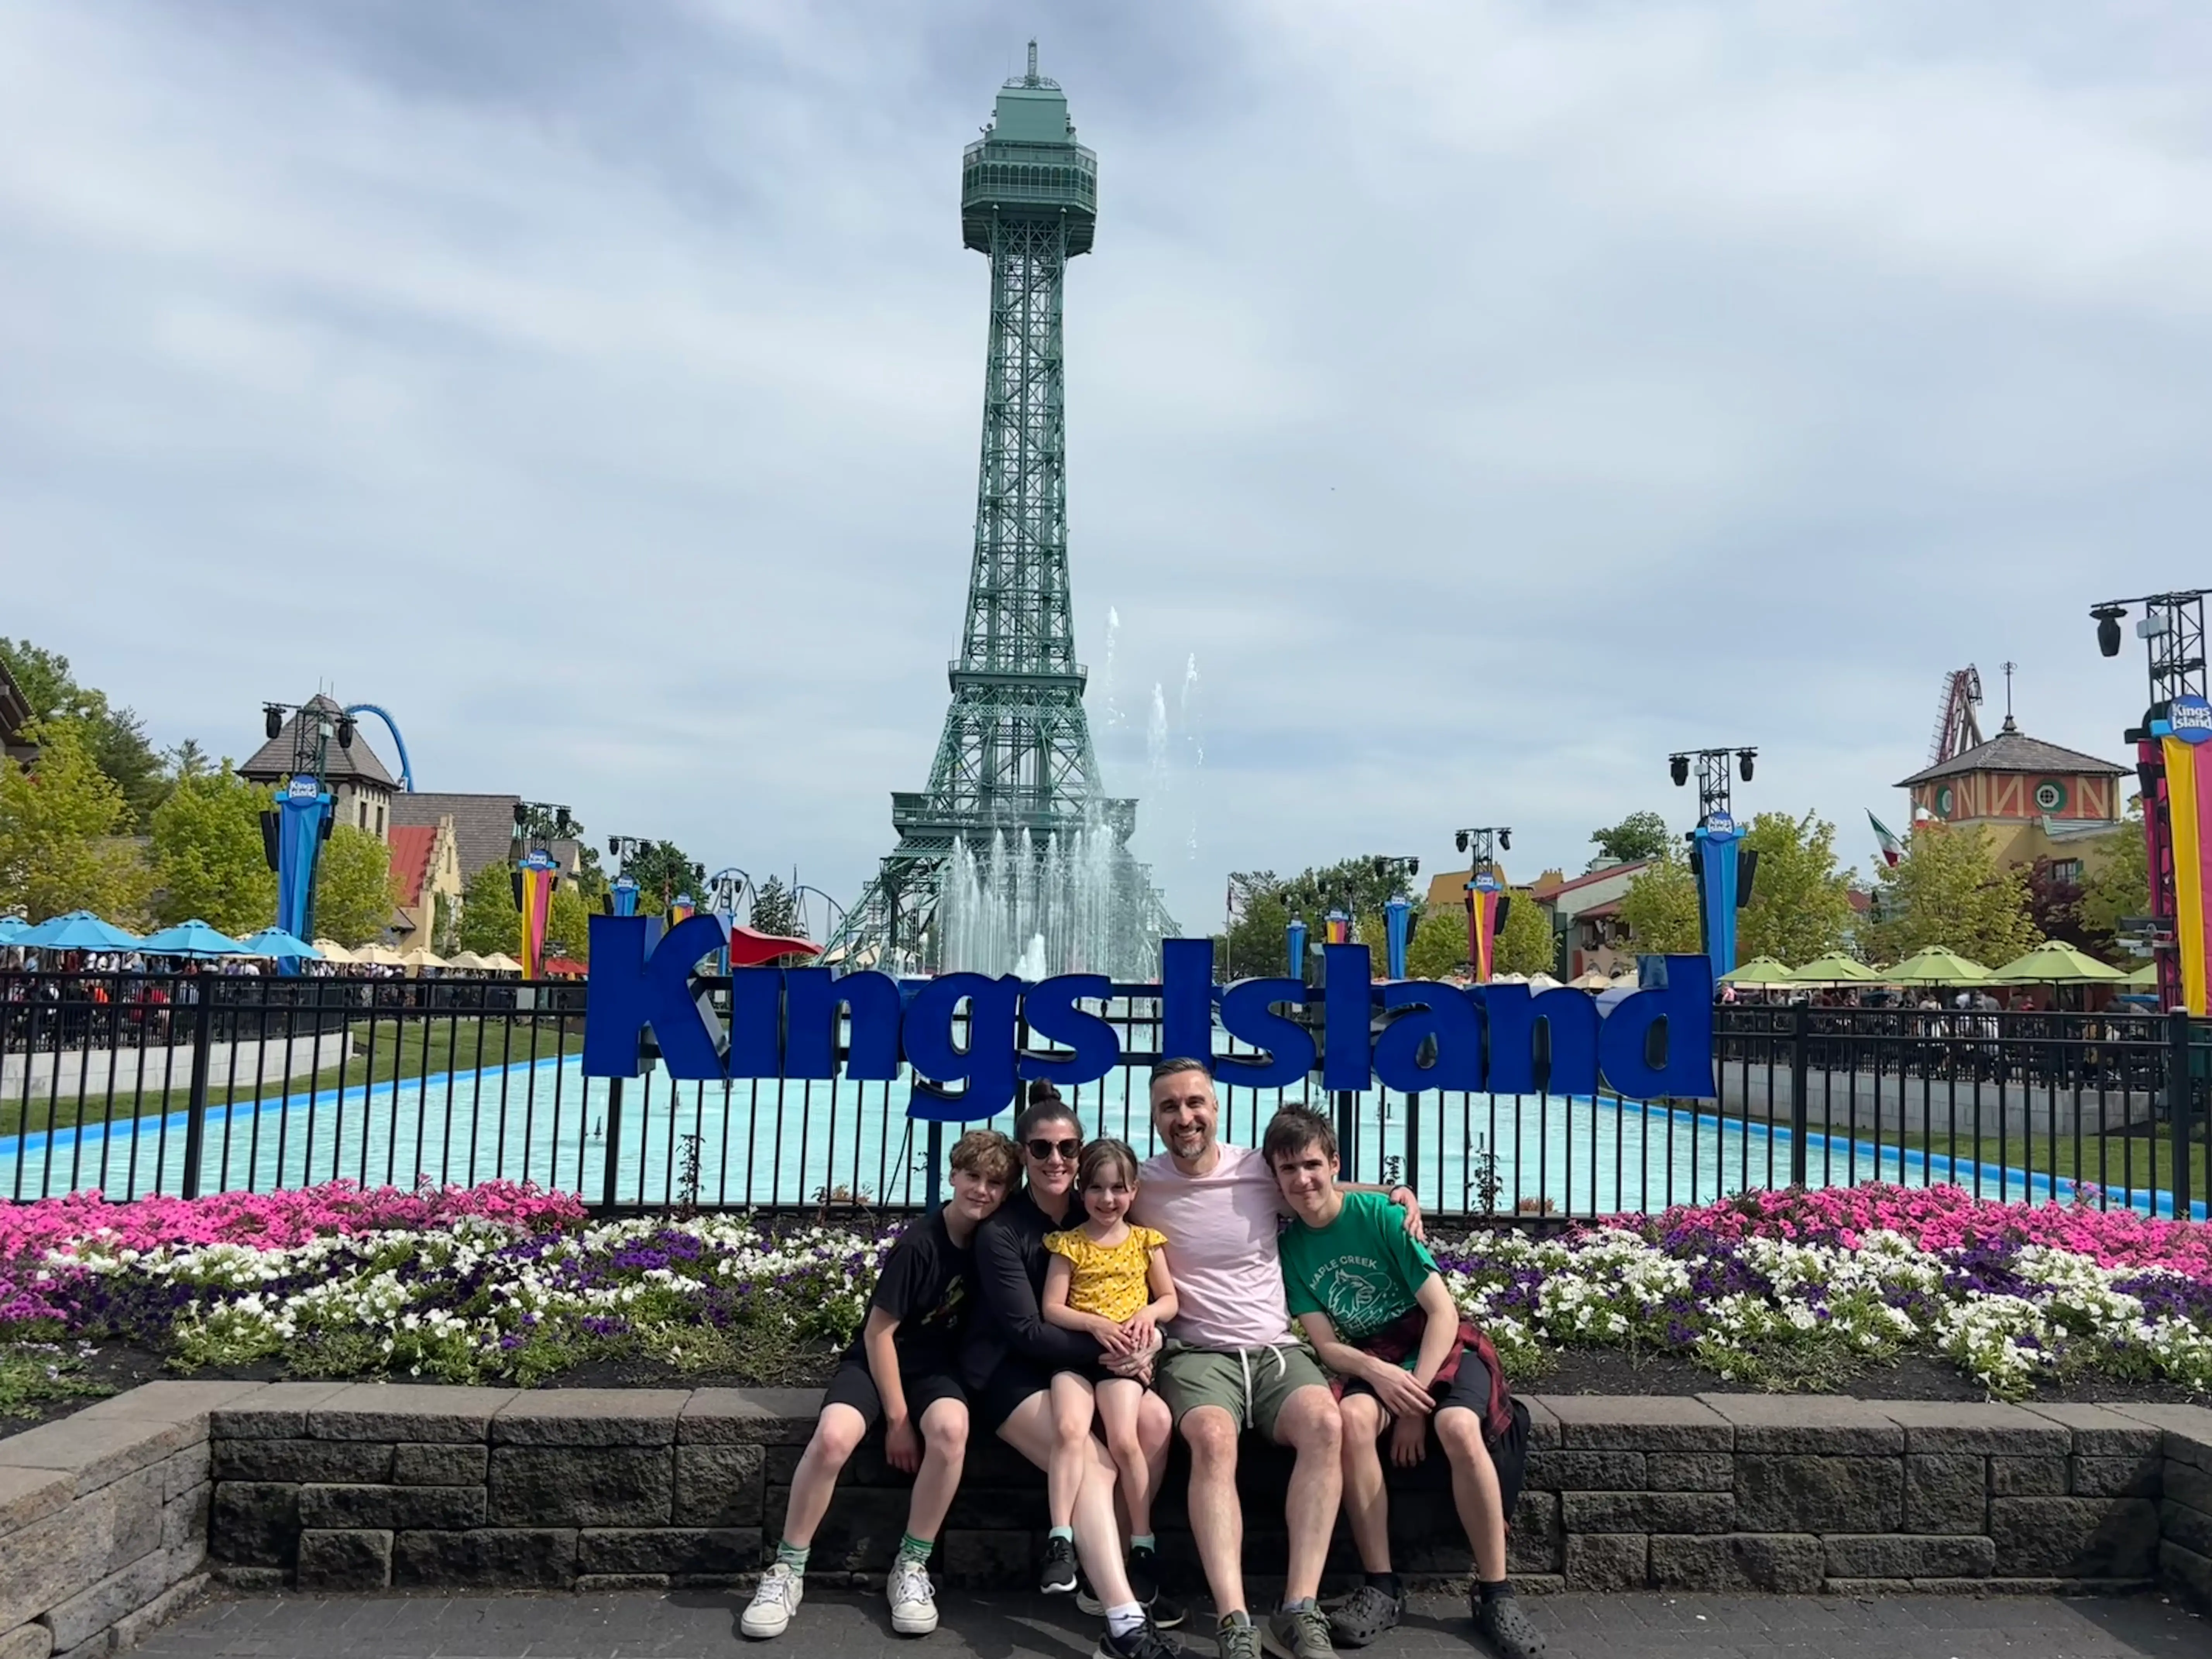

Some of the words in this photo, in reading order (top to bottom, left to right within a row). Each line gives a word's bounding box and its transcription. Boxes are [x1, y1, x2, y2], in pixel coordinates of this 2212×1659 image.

[2172, 703, 2210, 720] Kings
[2172, 716, 2212, 731] Island
[582, 914, 1120, 1121] Kings
[1162, 938, 1716, 1099] Island
[1309, 1259, 1338, 1290] MAPLE
[1339, 1255, 1377, 1270] CREEK
